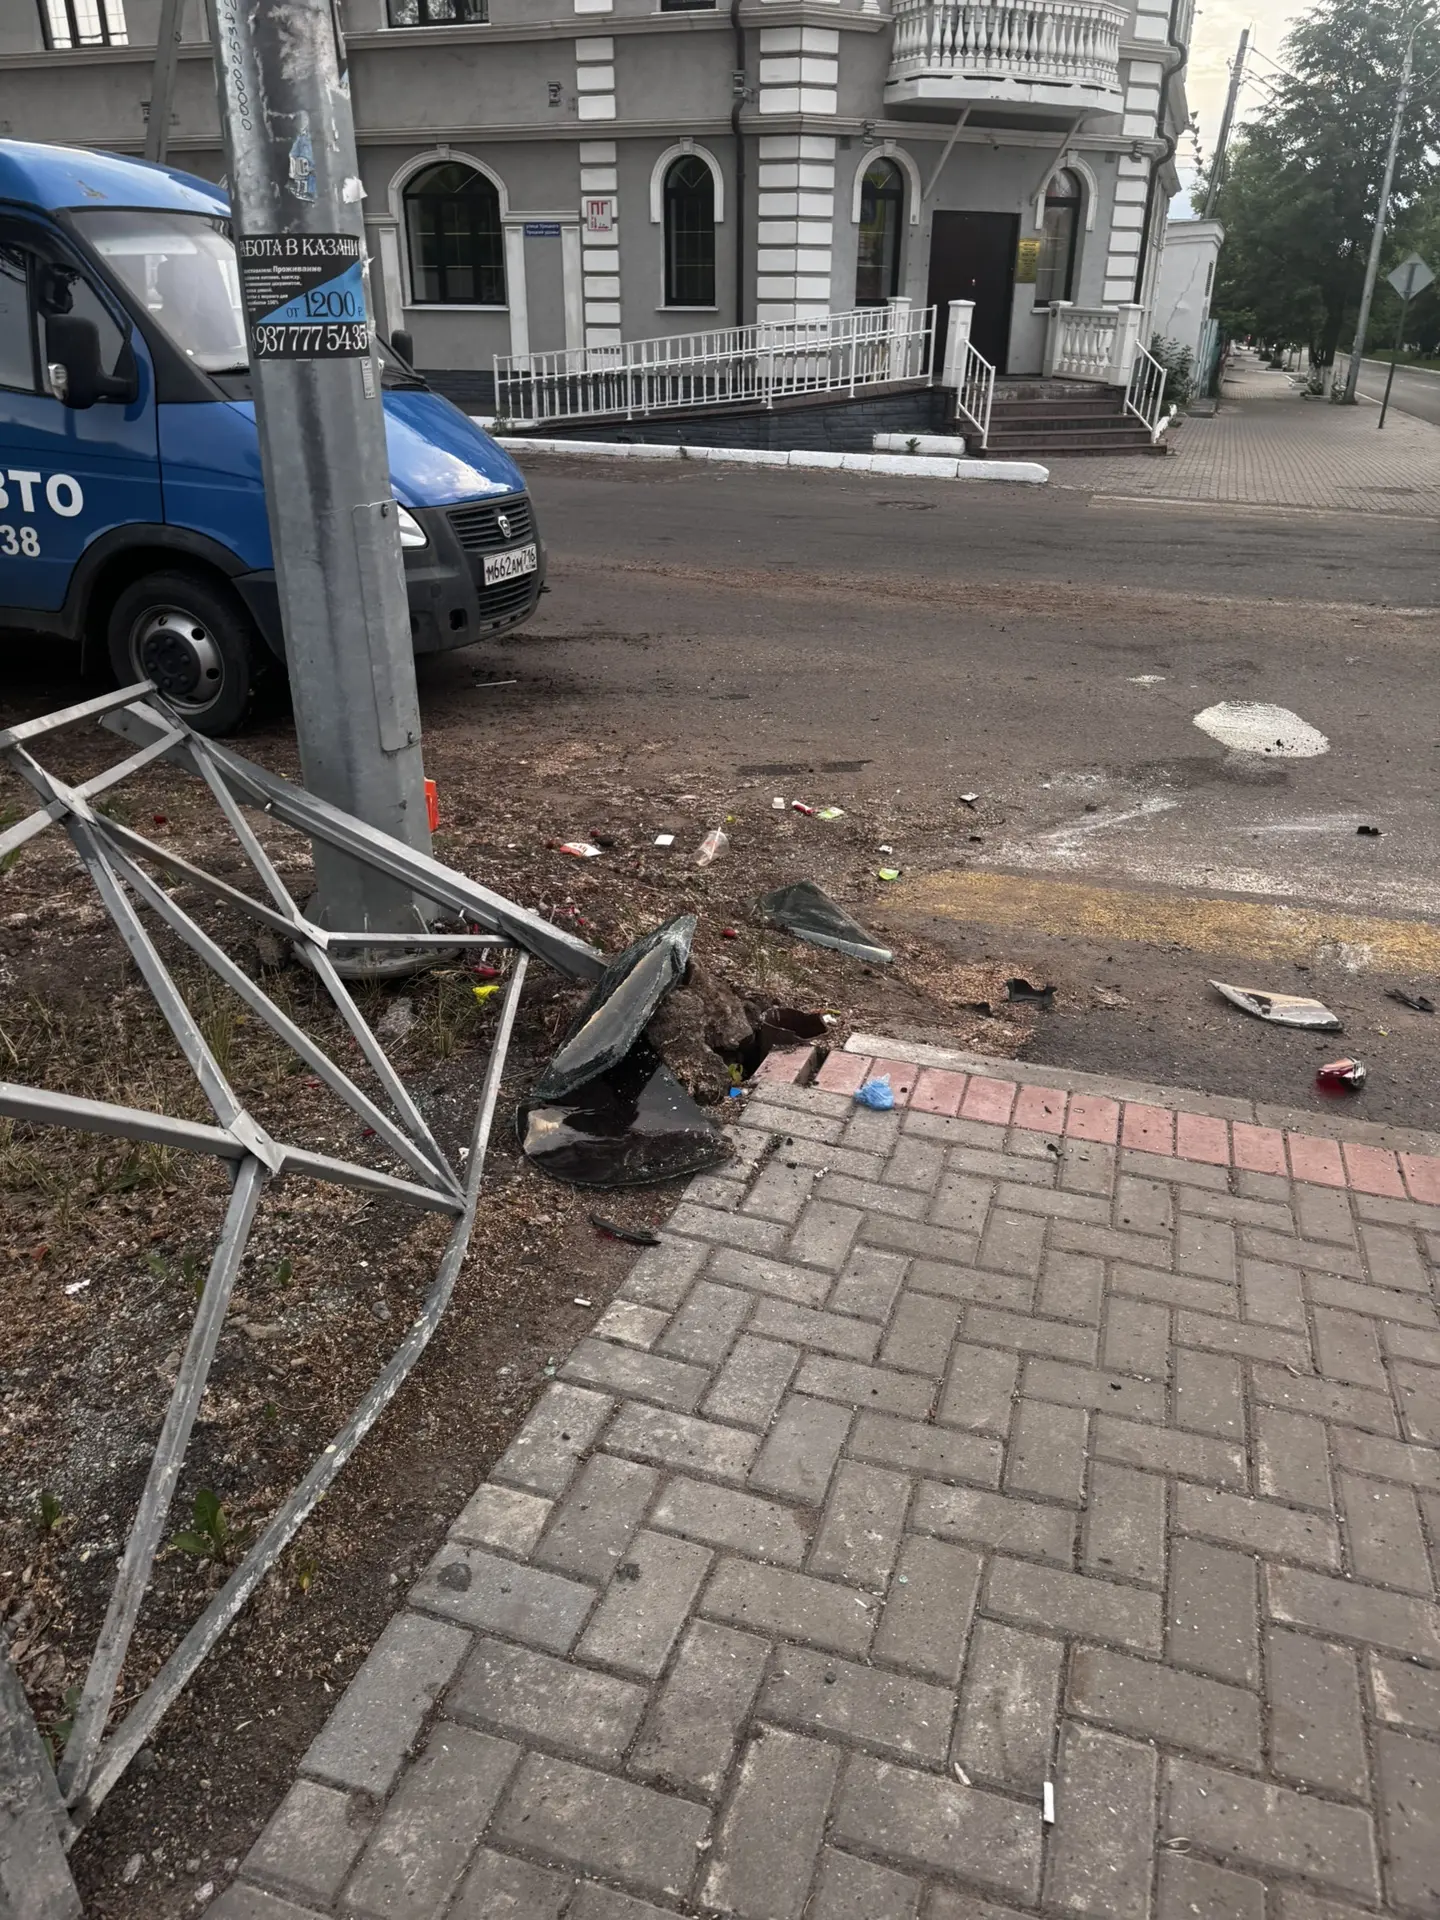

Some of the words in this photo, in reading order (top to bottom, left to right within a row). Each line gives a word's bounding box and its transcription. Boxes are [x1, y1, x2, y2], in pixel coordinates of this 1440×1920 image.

[286, 238, 298, 256] В
[302, 238, 359, 256] КАЗАНИ
[273, 265, 322, 273] Проживание
[304, 291, 355, 317] 1200
[289, 325, 323, 351] 777
